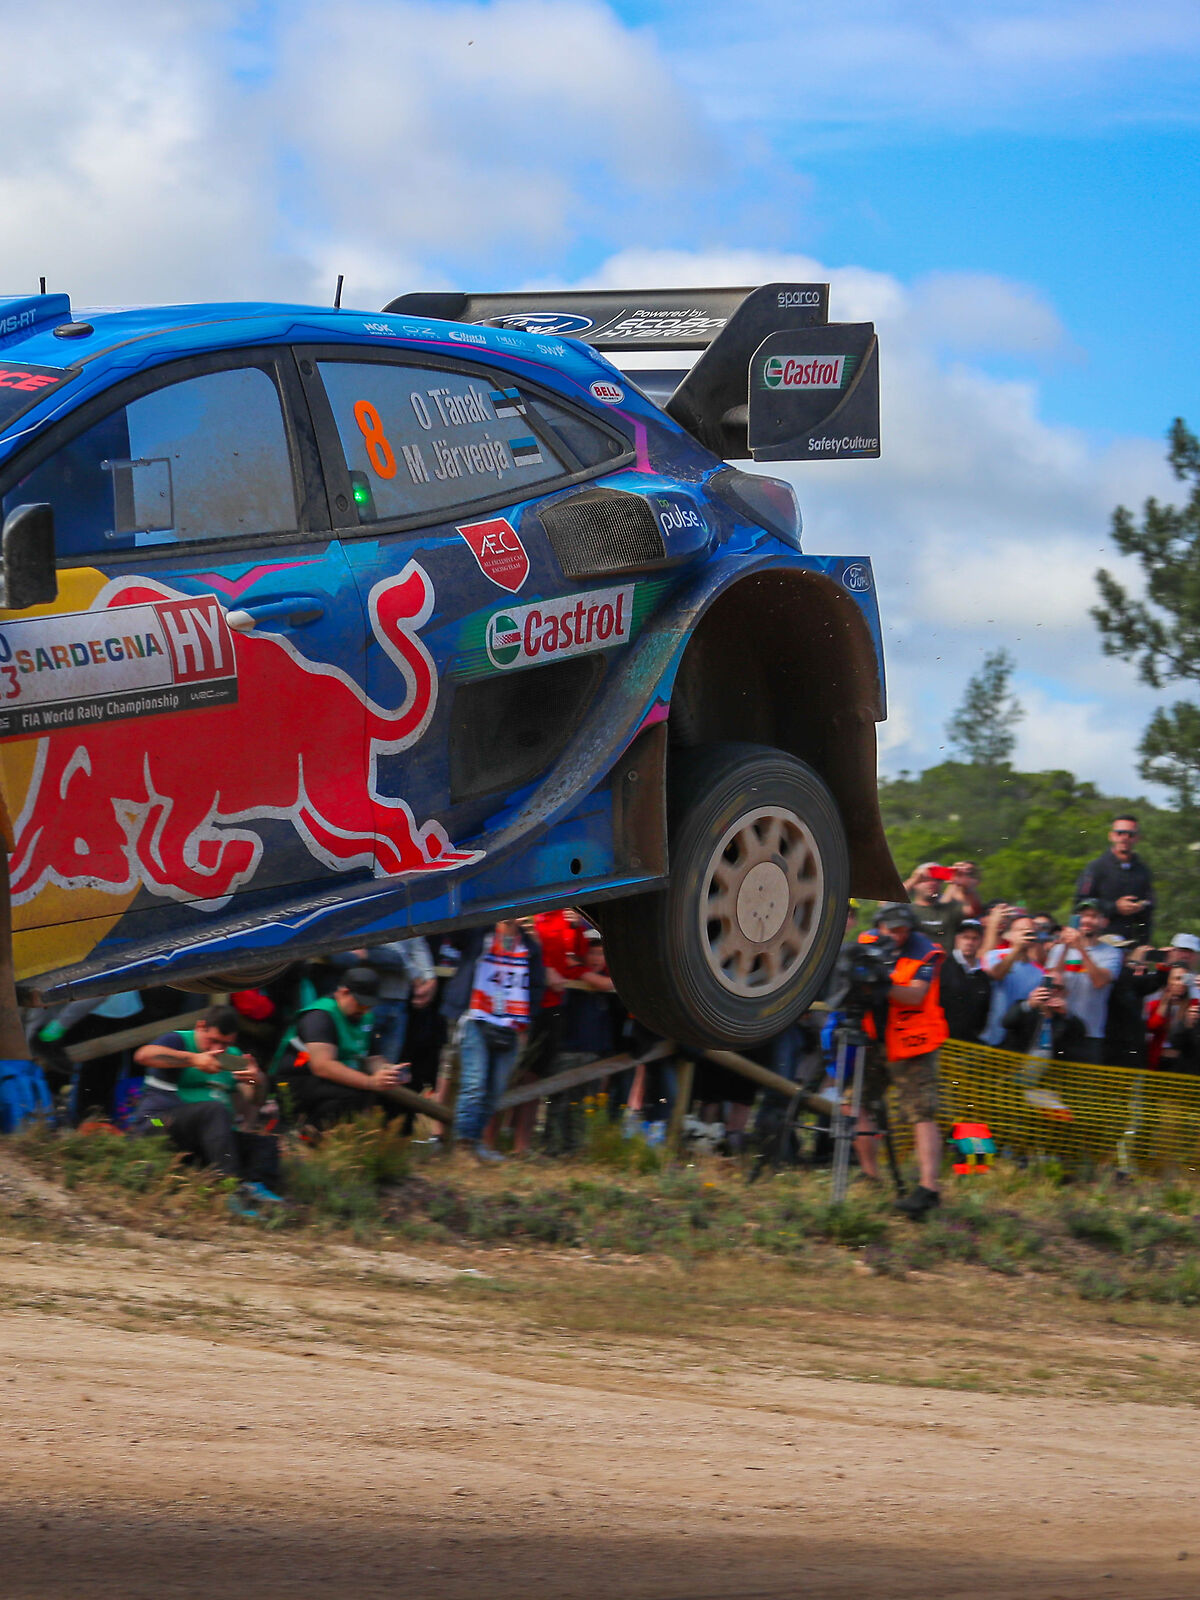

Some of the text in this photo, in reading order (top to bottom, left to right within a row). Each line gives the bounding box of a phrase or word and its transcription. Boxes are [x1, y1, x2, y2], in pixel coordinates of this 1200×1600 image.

[632, 309, 707, 319] Powered by
[777, 291, 820, 307] sparco
[595, 329, 708, 338] HYBRID
[614, 318, 728, 330] ECOBO
[783, 359, 839, 385] Castrol
[409, 385, 492, 430] O Tänak
[593, 386, 620, 397] BELL
[353, 400, 397, 480] 8
[808, 436, 878, 453] SafetyCulture
[400, 433, 510, 484] M Järveoja
[660, 504, 698, 536] pulse
[162, 605, 224, 675] HY
[523, 603, 625, 657] Castrol
[15, 633, 164, 673] SARDEGNA
[22, 713, 41, 728] FIA
[43, 708, 74, 724] World
[77, 705, 103, 721] Rally
[106, 694, 179, 715] Championship
[124, 895, 344, 959] ECOBOOST HYBRID
